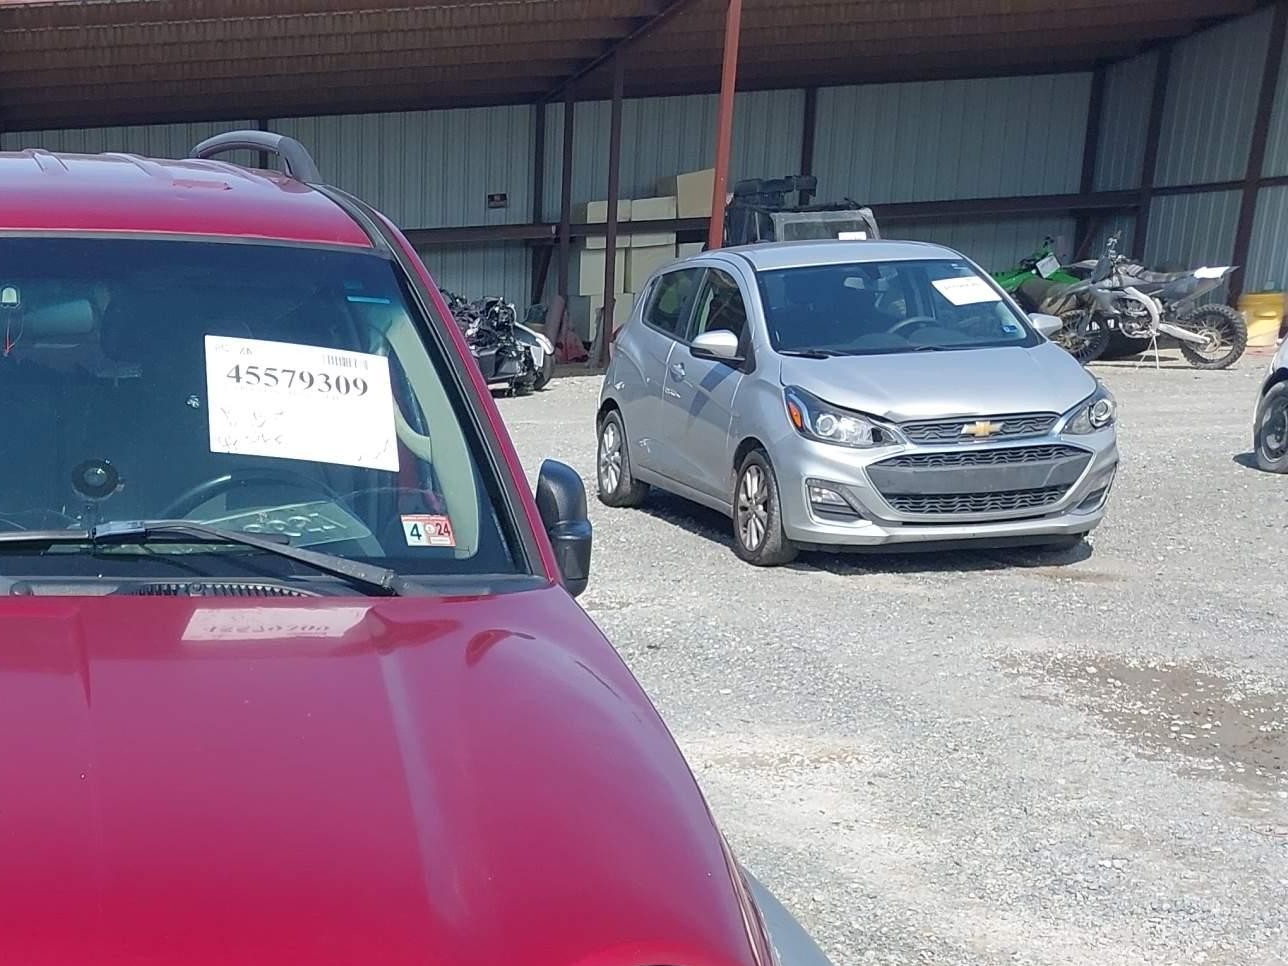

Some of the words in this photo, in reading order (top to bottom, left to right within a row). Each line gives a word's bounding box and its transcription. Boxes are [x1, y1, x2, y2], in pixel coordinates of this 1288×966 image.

[226, 364, 368, 396] 45579309
[410, 523, 422, 541] 4
[435, 522, 451, 537] 24
